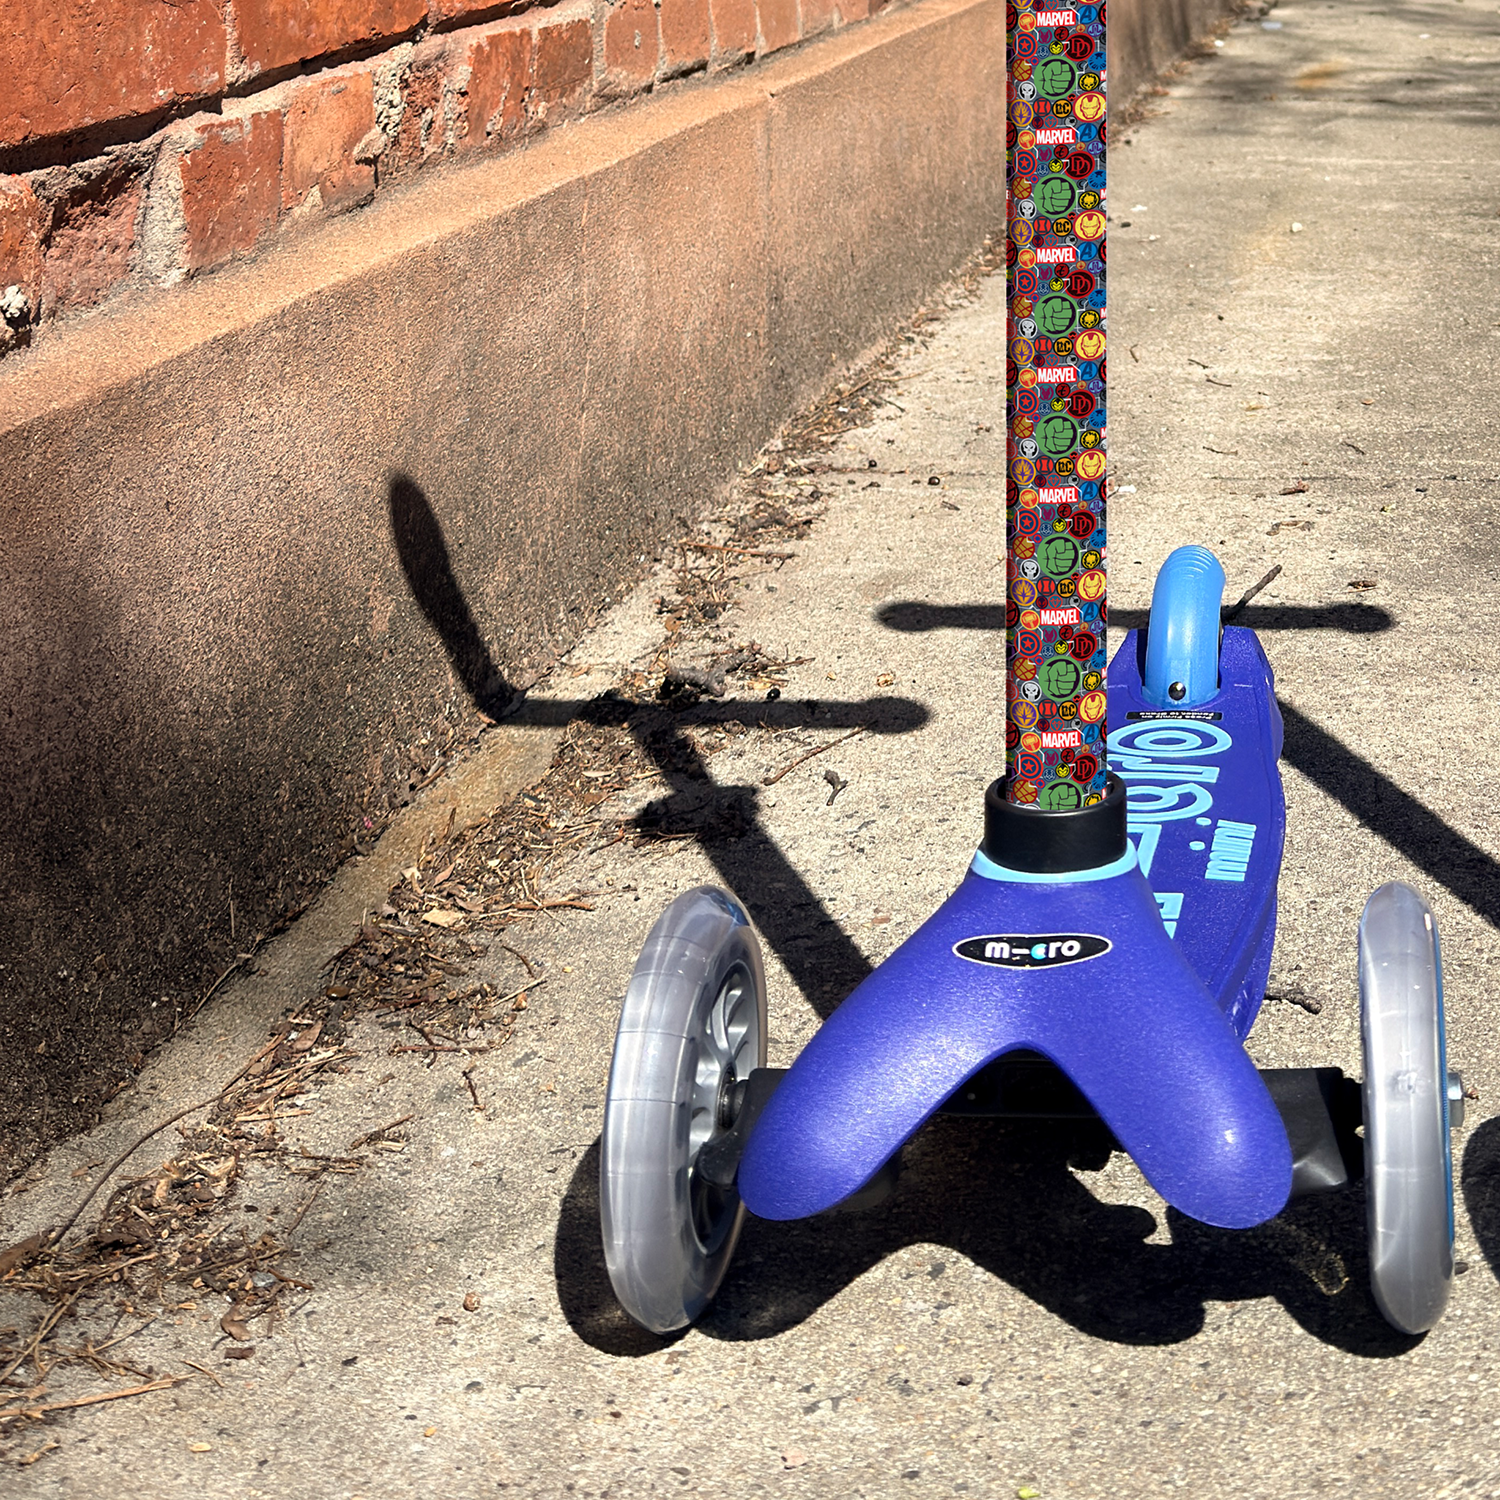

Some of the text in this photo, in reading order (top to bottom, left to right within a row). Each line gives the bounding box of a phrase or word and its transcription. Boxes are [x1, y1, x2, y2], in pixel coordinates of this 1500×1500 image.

[1036, 11, 1074, 27] MARVEL
[1035, 129, 1074, 145] MARVEL
[1036, 248, 1074, 264] MARVEL
[1037, 367, 1075, 383] MARVEL
[1039, 488, 1076, 504] MARVEL
[1040, 609, 1078, 625] MARVEL
[1041, 732, 1080, 748] MARVEL
[1189, 817, 1257, 882] mini
